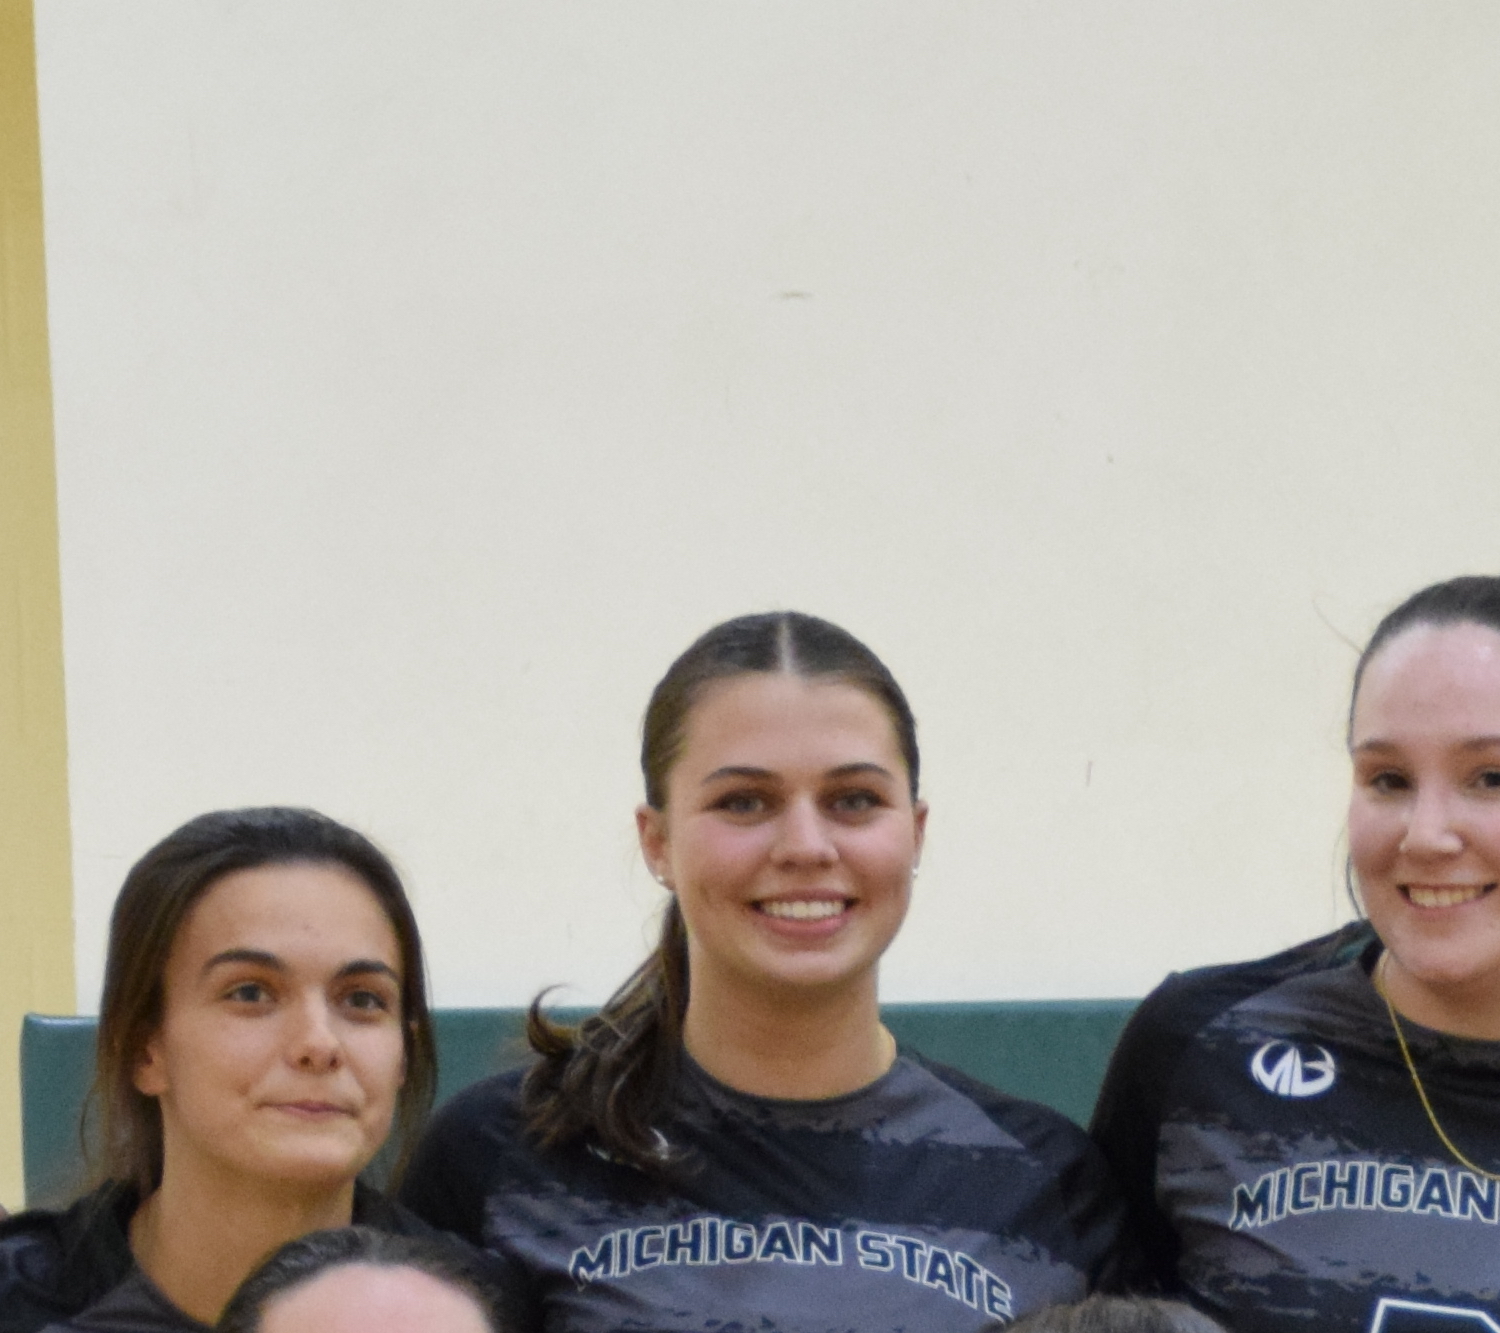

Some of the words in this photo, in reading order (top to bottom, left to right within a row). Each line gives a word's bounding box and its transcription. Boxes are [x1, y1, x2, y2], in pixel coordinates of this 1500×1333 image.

[1228, 1160, 1500, 1230] MICHIGAN
[569, 1217, 843, 1291] MICHIGAN
[857, 1230, 1013, 1324] STATE
